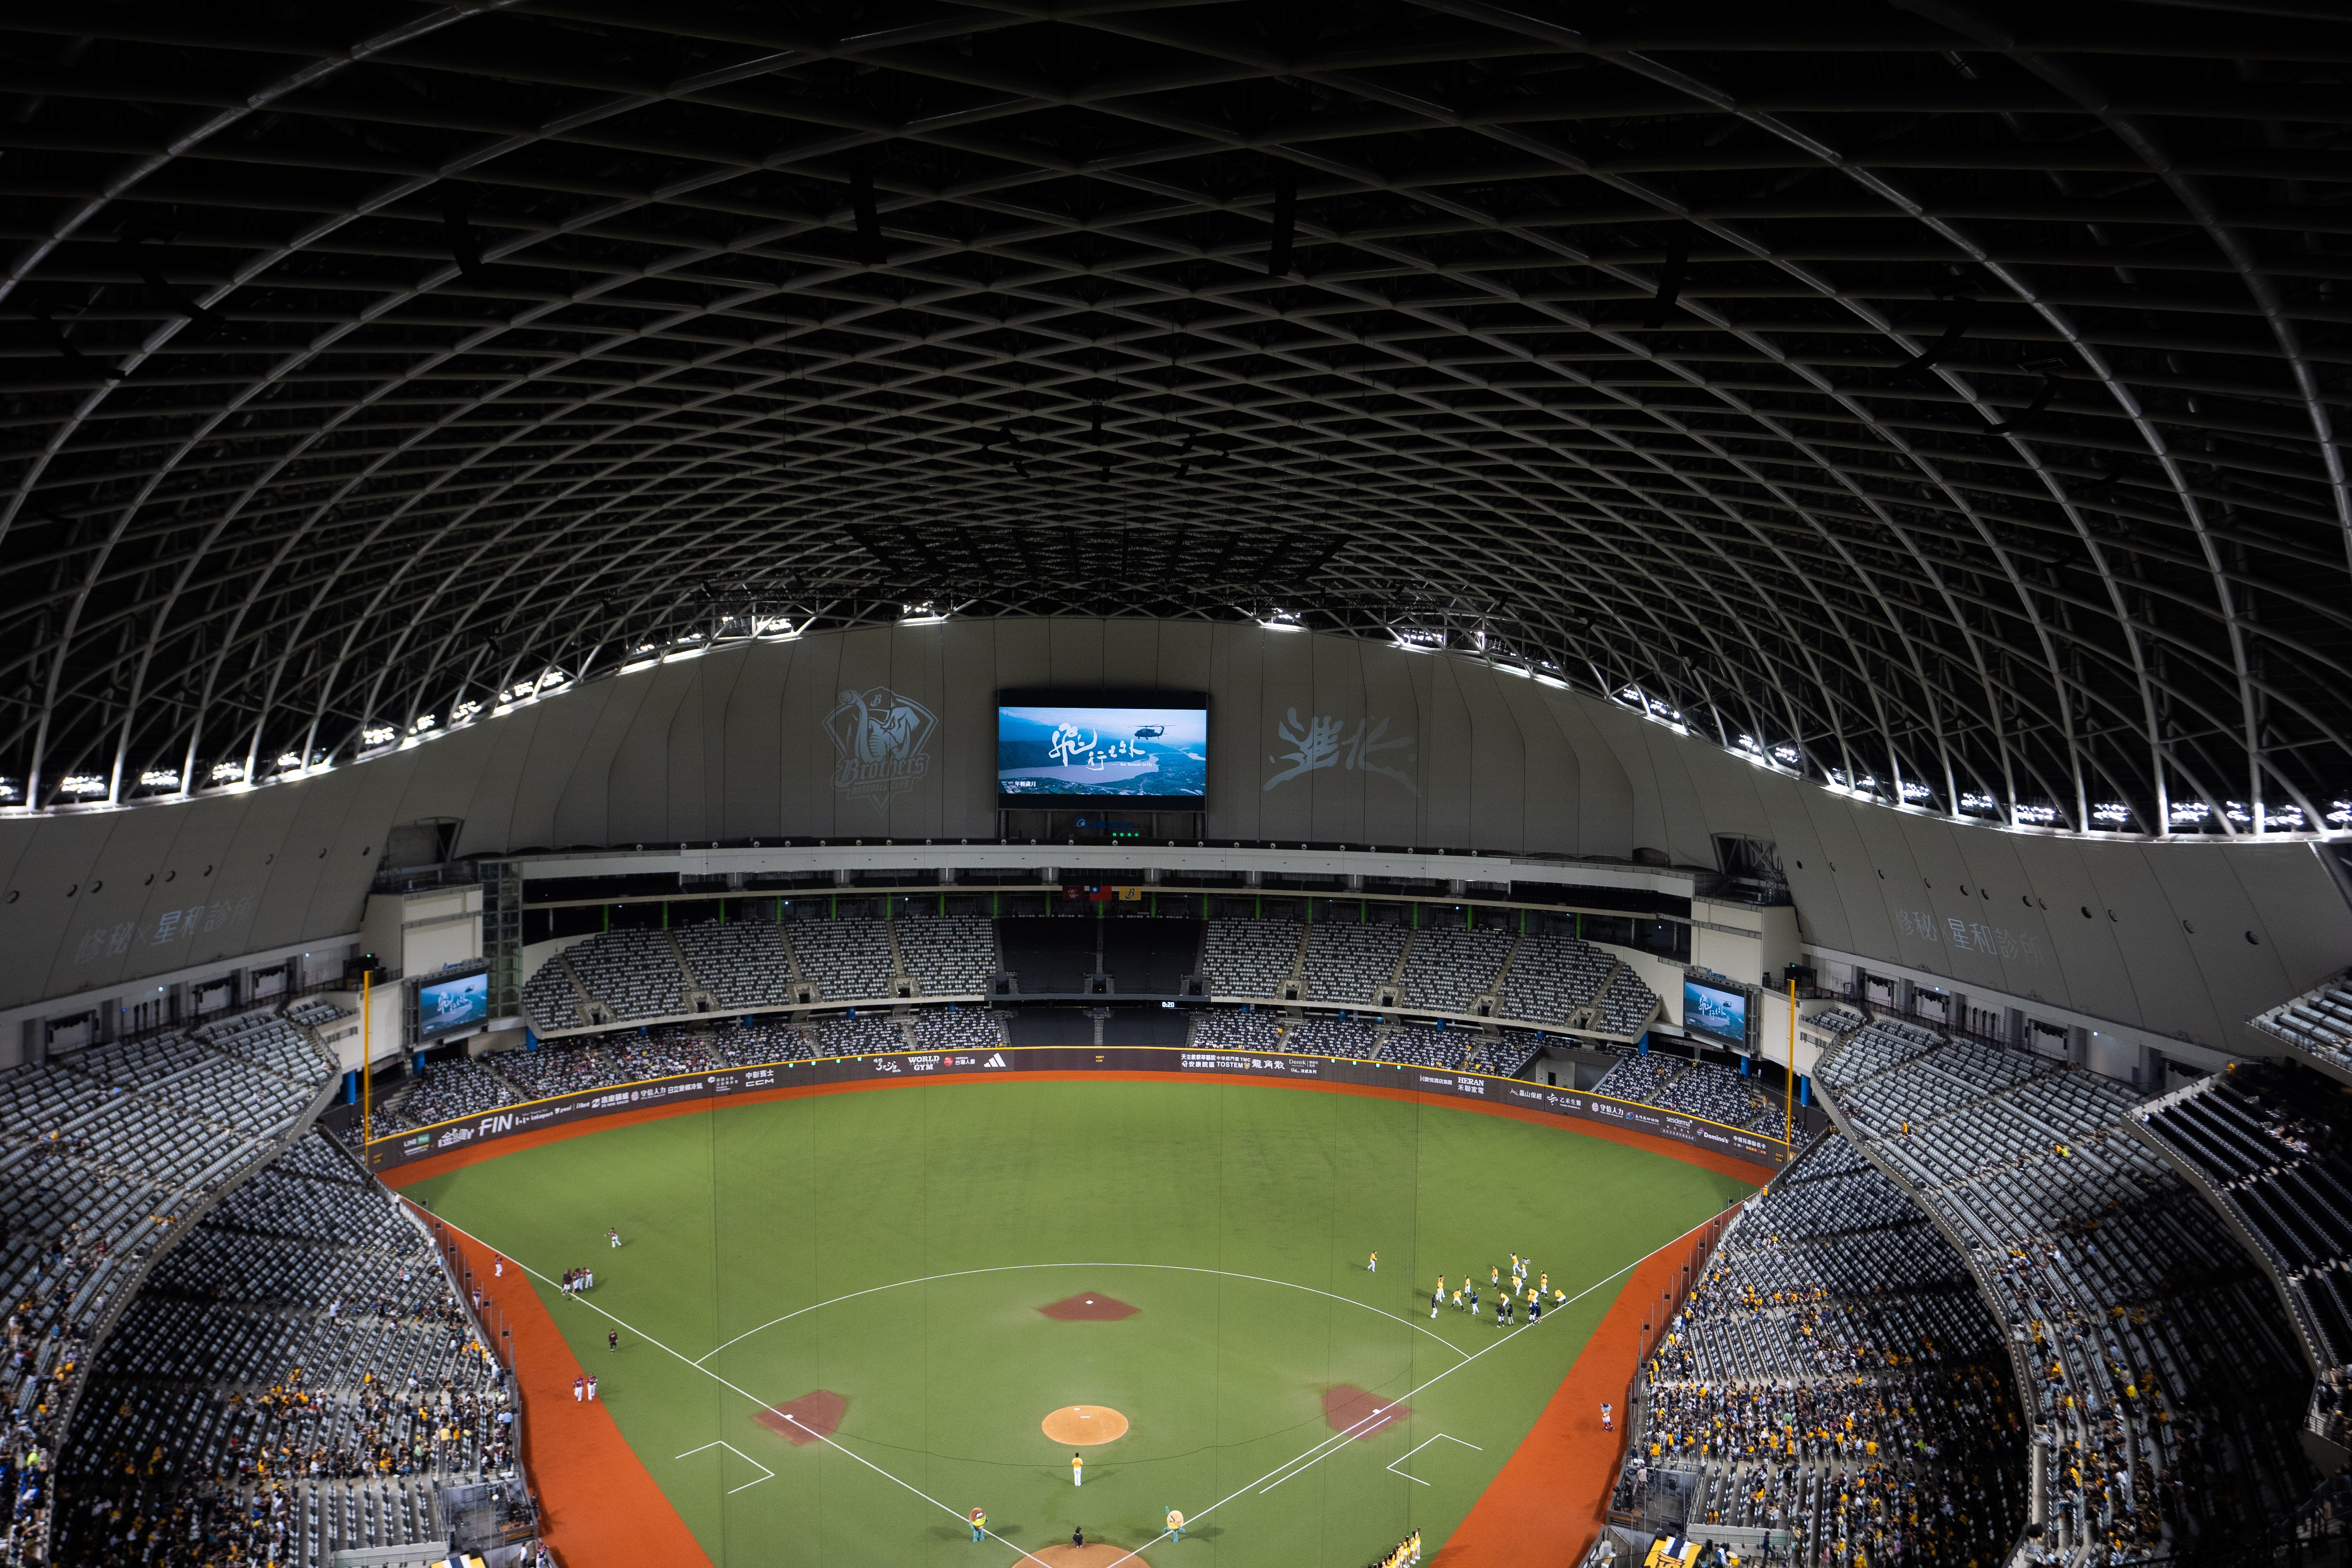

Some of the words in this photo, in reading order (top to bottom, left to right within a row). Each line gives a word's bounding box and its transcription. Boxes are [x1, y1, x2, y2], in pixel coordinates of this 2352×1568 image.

[1252, 1059, 1285, 1069] 龍角散
[746, 1078, 774, 1087] CCM
[1458, 1077, 1484, 1086] HERAN
[640, 1087, 666, 1097] 守信人力
[1458, 1085, 1484, 1094] 禾聯家電
[1519, 1089, 1543, 1100] 磊山保經
[1559, 1097, 1581, 1106] 乙禾生醫
[1600, 1104, 1623, 1116] 守信人力
[478, 1113, 513, 1136] FIN
[1666, 1116, 1690, 1127] sesderma
[404, 1138, 417, 1147] LINE
[1704, 1132, 1729, 1143] Domino's
